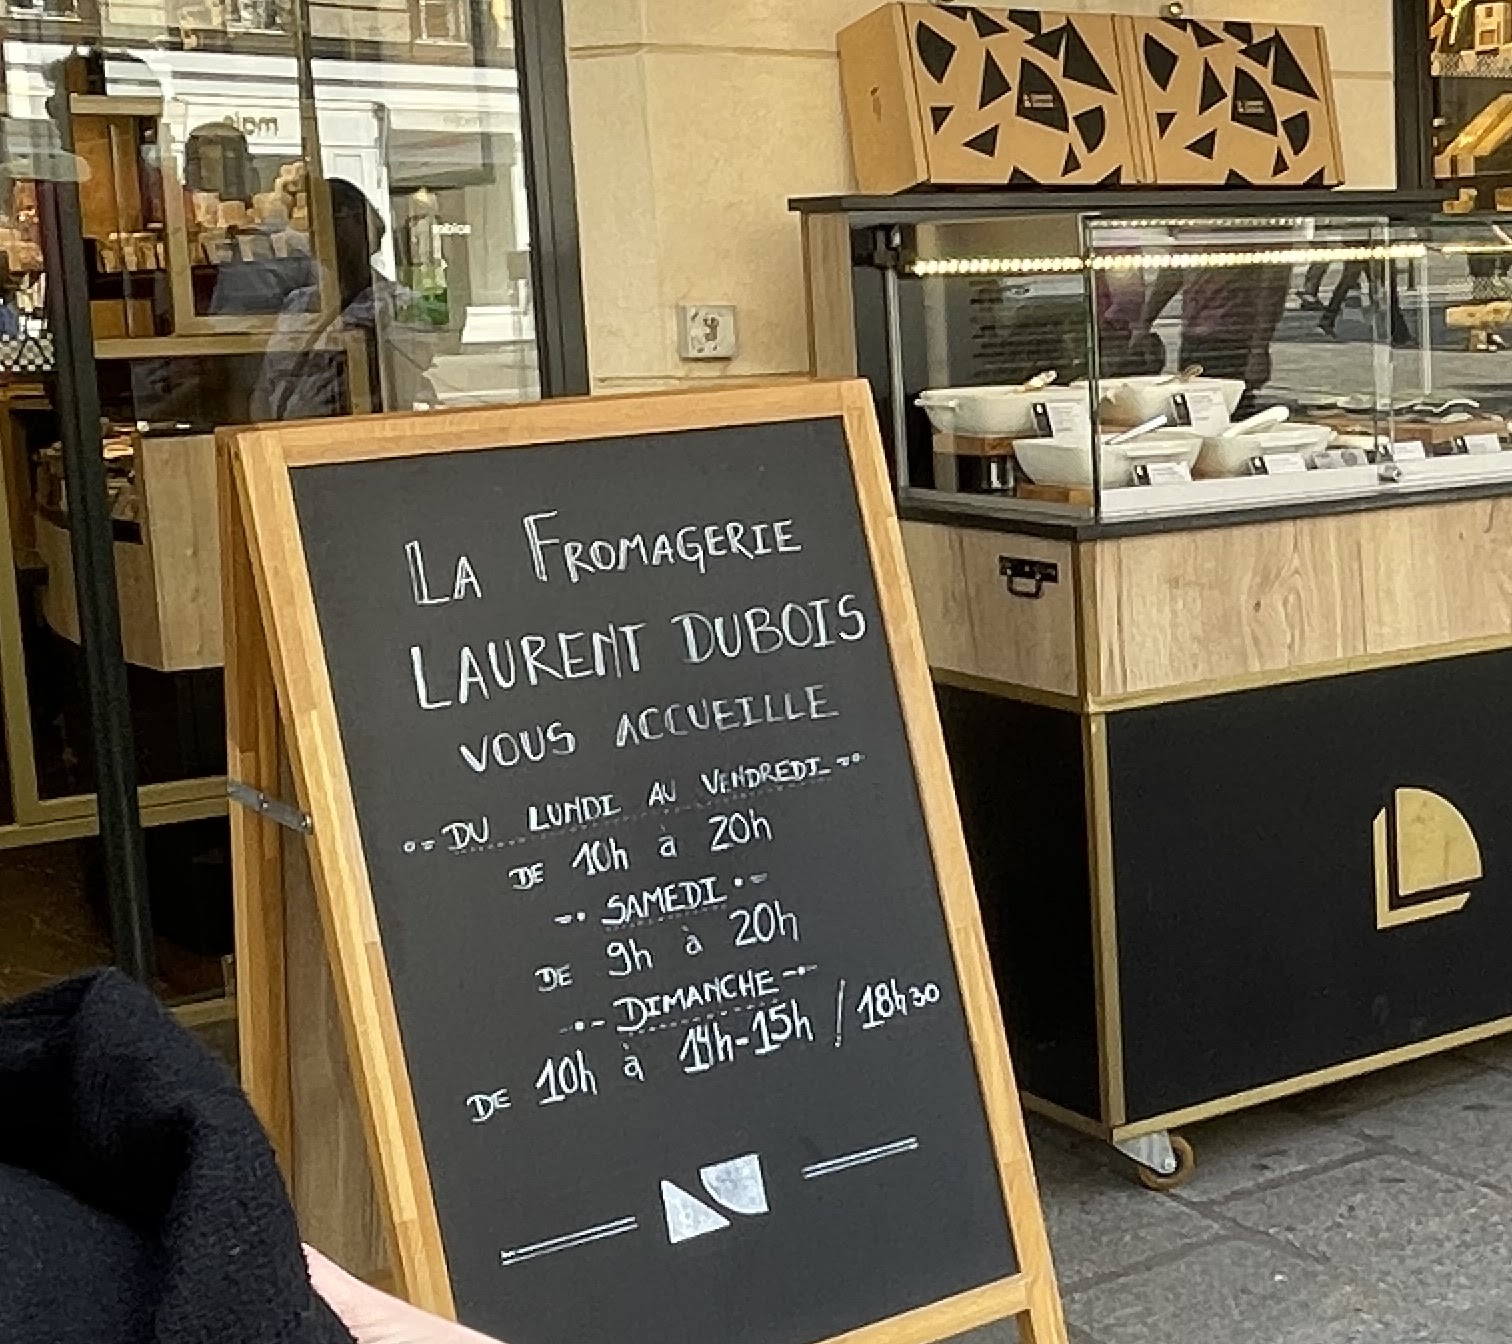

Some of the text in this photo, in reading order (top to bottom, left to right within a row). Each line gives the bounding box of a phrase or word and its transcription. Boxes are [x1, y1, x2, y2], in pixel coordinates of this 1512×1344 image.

[522, 510, 802, 584] FROMAGERIE
[410, 594, 866, 710] LAURENT DUBOIS
[459, 684, 840, 772] VOUS ACCUEILLE
[440, 756, 832, 849] DU LUNDI AU VENDREDI
[508, 808, 772, 890] DE 10h à 20h
[600, 876, 728, 924] SAMEDI
[534, 900, 799, 992] DE 9h à 20h
[612, 968, 780, 1032] DIMANCHE
[466, 1088, 512, 1123] DE
[534, 1048, 598, 1105] 10h
[622, 1042, 645, 1082] à
